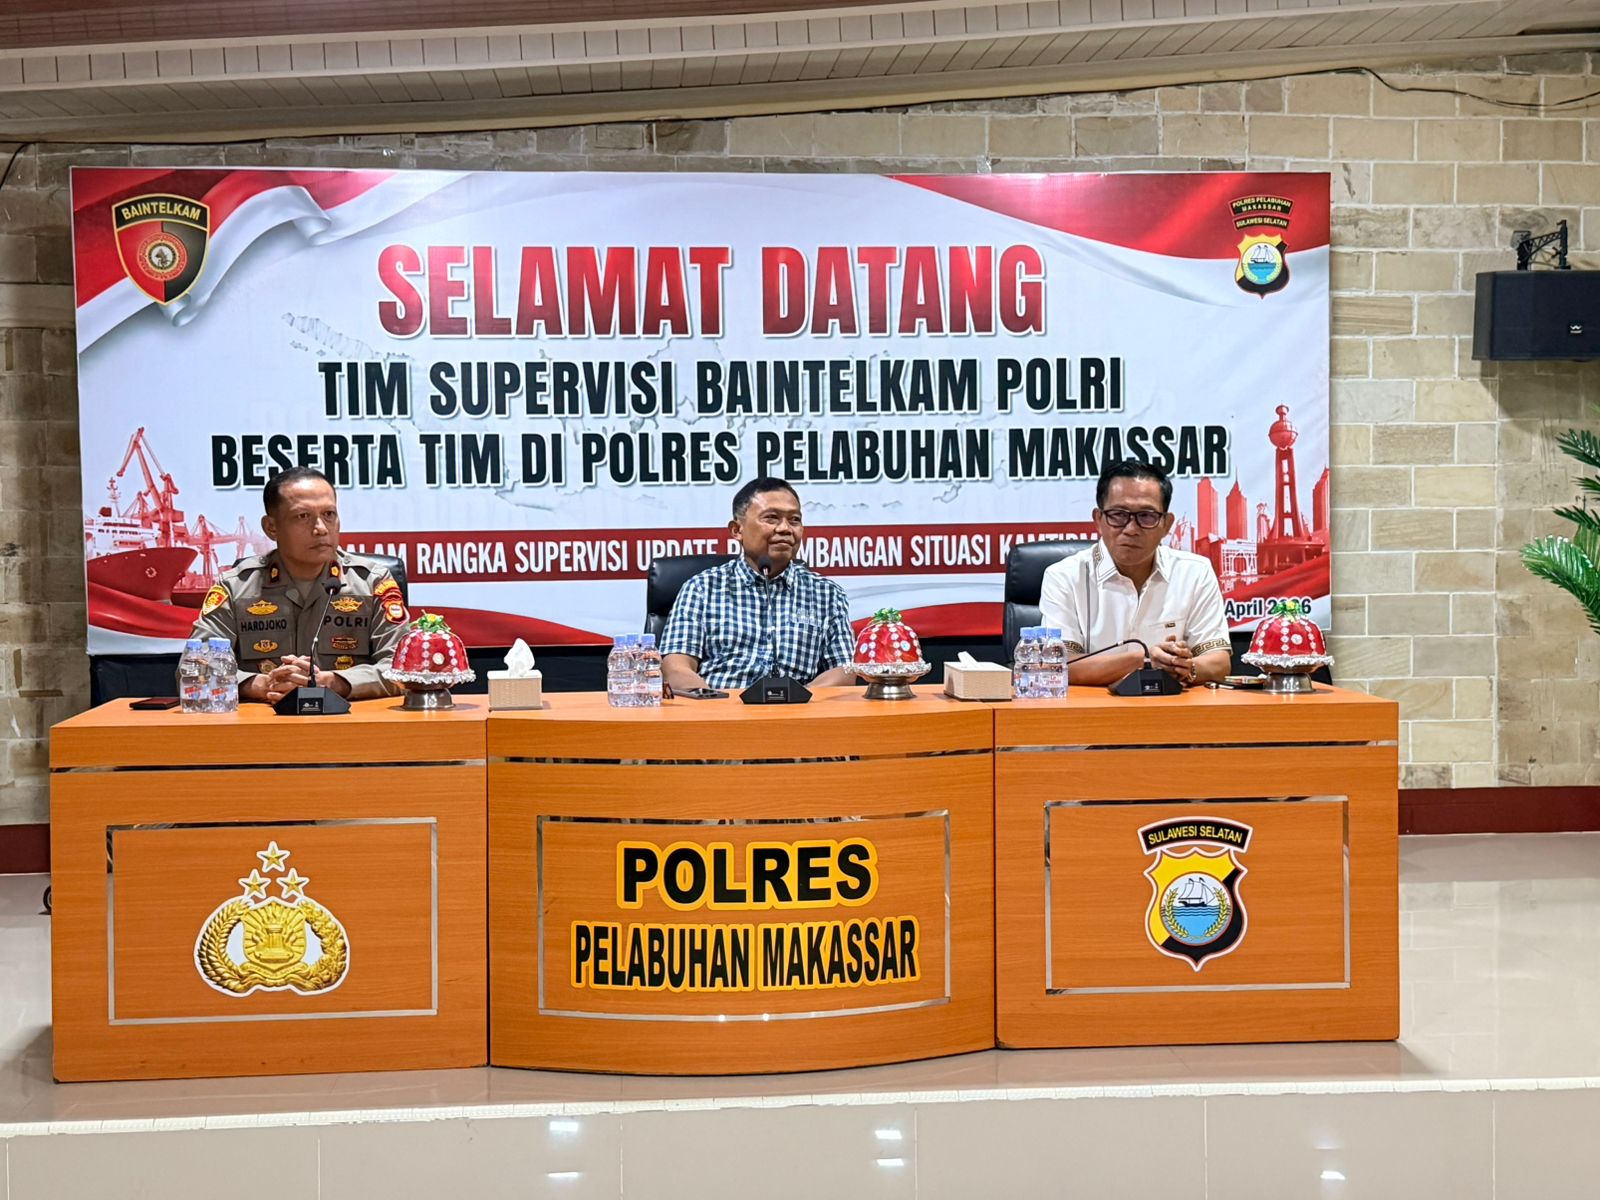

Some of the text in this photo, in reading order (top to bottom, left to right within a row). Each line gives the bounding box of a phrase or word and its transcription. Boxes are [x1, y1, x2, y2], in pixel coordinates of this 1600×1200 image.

[121, 202, 201, 220] BAINTELKAM
[1232, 196, 1291, 208] POLRES PELABUHAN
[1236, 218, 1287, 228] SULAWESI SELATAN
[377, 243, 1045, 337] SELAMAT DATANG
[318, 356, 1121, 416] TIM SUPERVISI BAINTELKAM POLRI
[211, 425, 1227, 486] BESERTA TIM DI POLRES PELABUHAN MAKASSAR
[416, 542, 506, 575] RANGKA
[514, 540, 628, 573] SUPERVISI
[910, 533, 991, 567] SITUASI
[1224, 598, 1312, 619] April 26
[240, 618, 288, 632] HARDJOKO
[323, 616, 368, 629] POLRI
[1148, 825, 1243, 845] SULAWESI SELATAN
[623, 843, 872, 904] POLRES
[575, 919, 917, 989] PELABUHAN MAKASSAR
